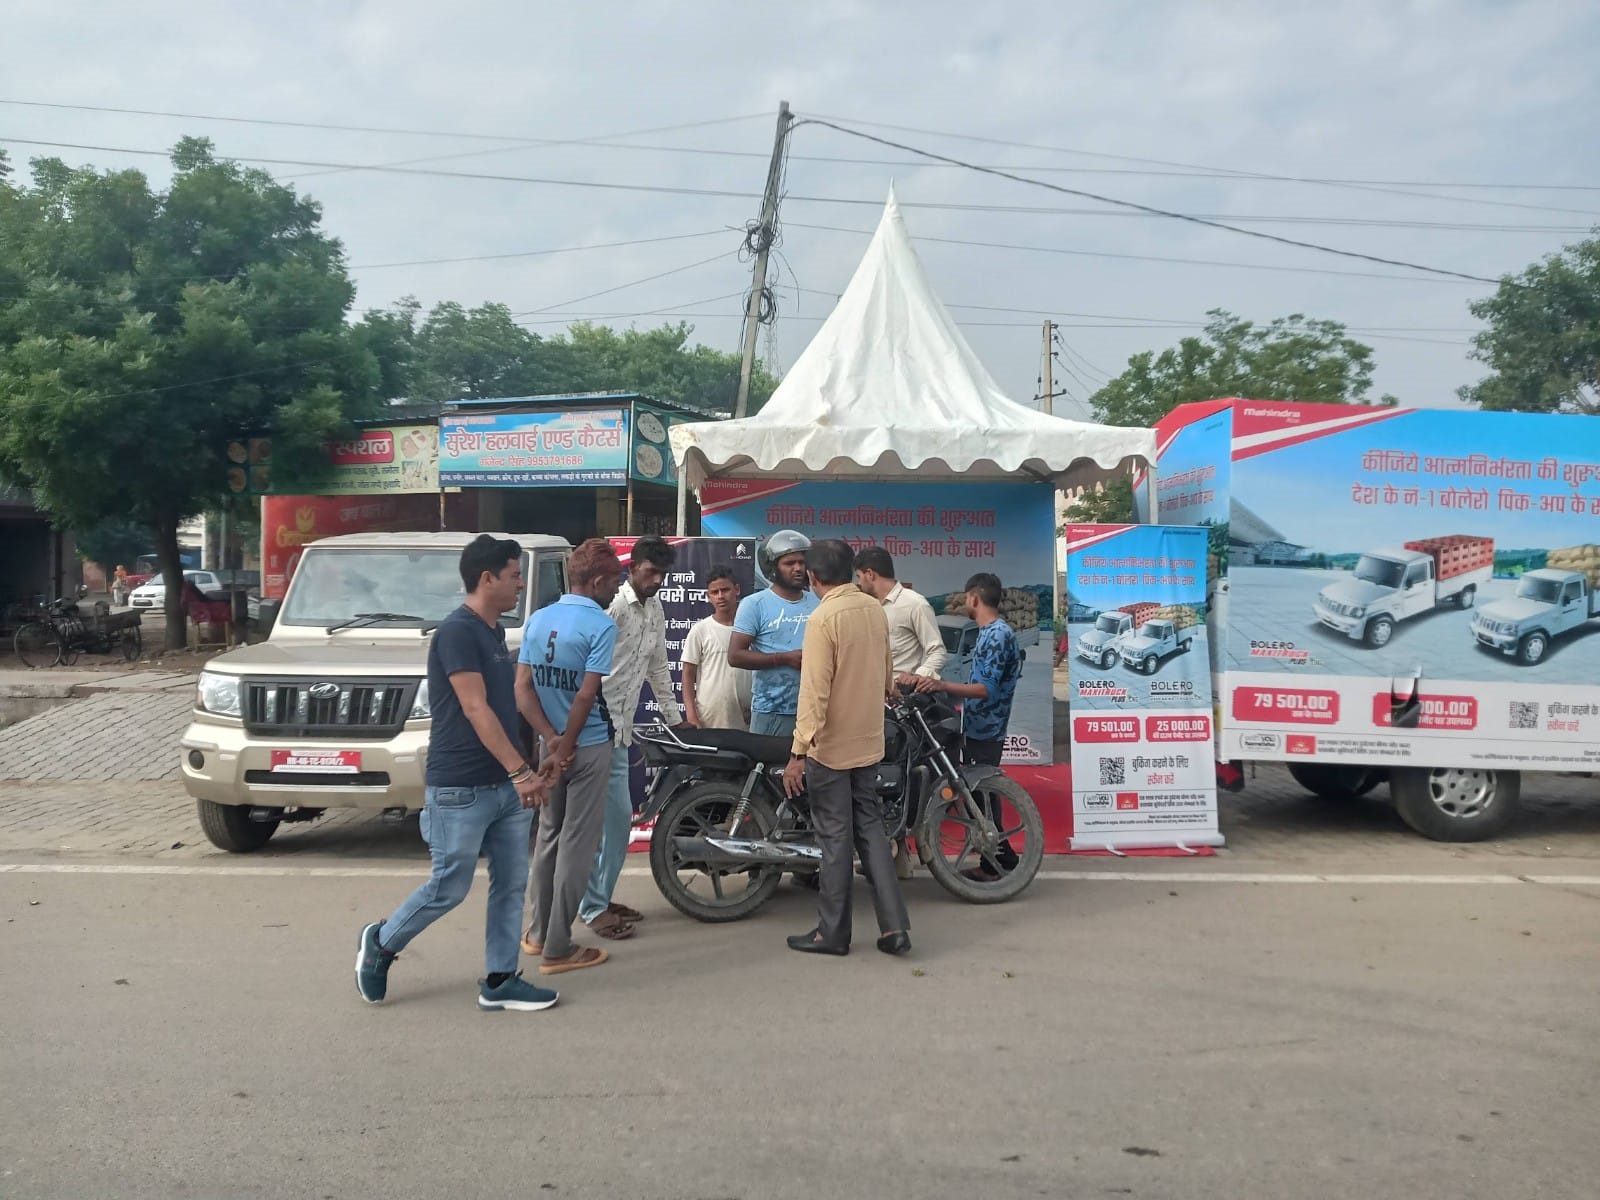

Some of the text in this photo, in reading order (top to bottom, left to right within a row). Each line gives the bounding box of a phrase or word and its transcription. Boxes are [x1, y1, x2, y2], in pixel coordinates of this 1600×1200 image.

[445, 427, 481, 457] सुरेश
[485, 423, 539, 453] हलवाई
[542, 429, 575, 451] एण्ड
[1361, 449, 1419, 473] कीजिये
[1537, 458, 1559, 481] की
[1352, 481, 1379, 505] देश
[1383, 481, 1400, 505] के
[1440, 485, 1489, 511] बोलेरो
[1570, 491, 1586, 514] के
[767, 504, 815, 526] कीजिये
[917, 505, 936, 527] की
[947, 536, 961, 558] के
[963, 540, 996, 558] साथ
[672, 570, 696, 583] माने
[660, 585, 686, 603] बसे
[545, 630, 558, 663] 5
[1250, 640, 1295, 650] BOLERO
[1079, 680, 1115, 689] BOLERO
[1079, 688, 1128, 696] MAXITRUCK
[1151, 681, 1193, 691] BOLERO
[1253, 692, 1273, 708] 79
[1087, 721, 1098, 732] 79
[1157, 721, 1169, 731] 25
